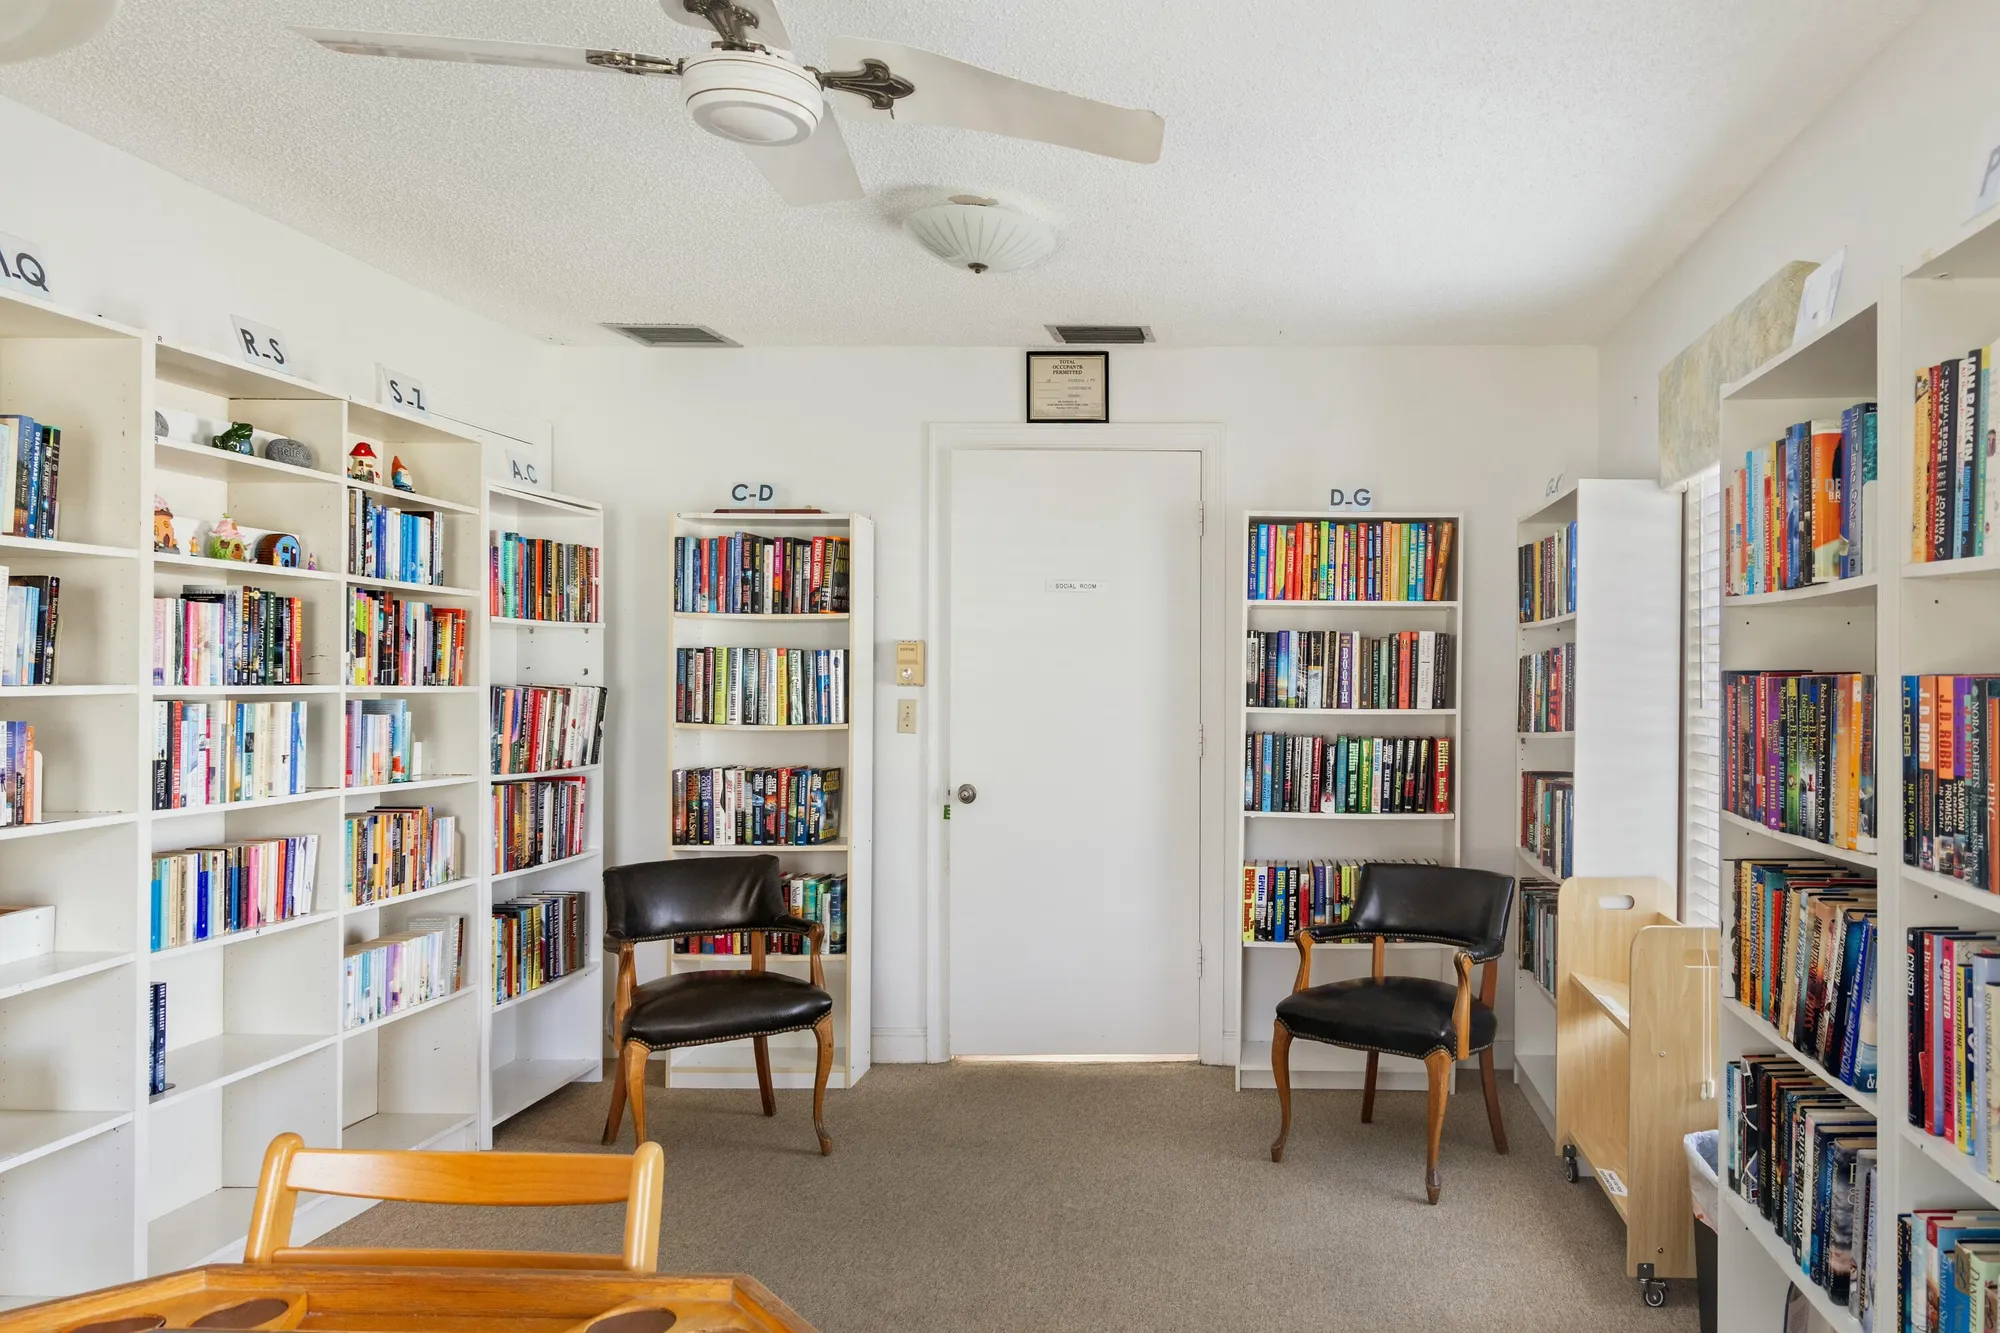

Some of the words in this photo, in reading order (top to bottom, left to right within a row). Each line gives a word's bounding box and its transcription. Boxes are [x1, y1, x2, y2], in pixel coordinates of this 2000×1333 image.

[1966, 356, 1976, 390] IAN
[1851, 408, 1859, 438] THE
[1942, 394, 1950, 462] WHALEBONE
[1964, 393, 1974, 462] RANKIN
[1850, 444, 1859, 482] ZERO
[1850, 489, 1858, 529] GAME
[1349, 743, 1359, 771] Griffin
[1438, 740, 1448, 772] Griffin
[1919, 722, 1930, 762] ROBB
[1940, 730, 1952, 769] ROBB
[1972, 738, 1980, 788] ROBERTS
[792, 886, 800, 904] Nelson
[1245, 868, 1256, 900] Griffin
[1810, 944, 1820, 984] PATTERSON
